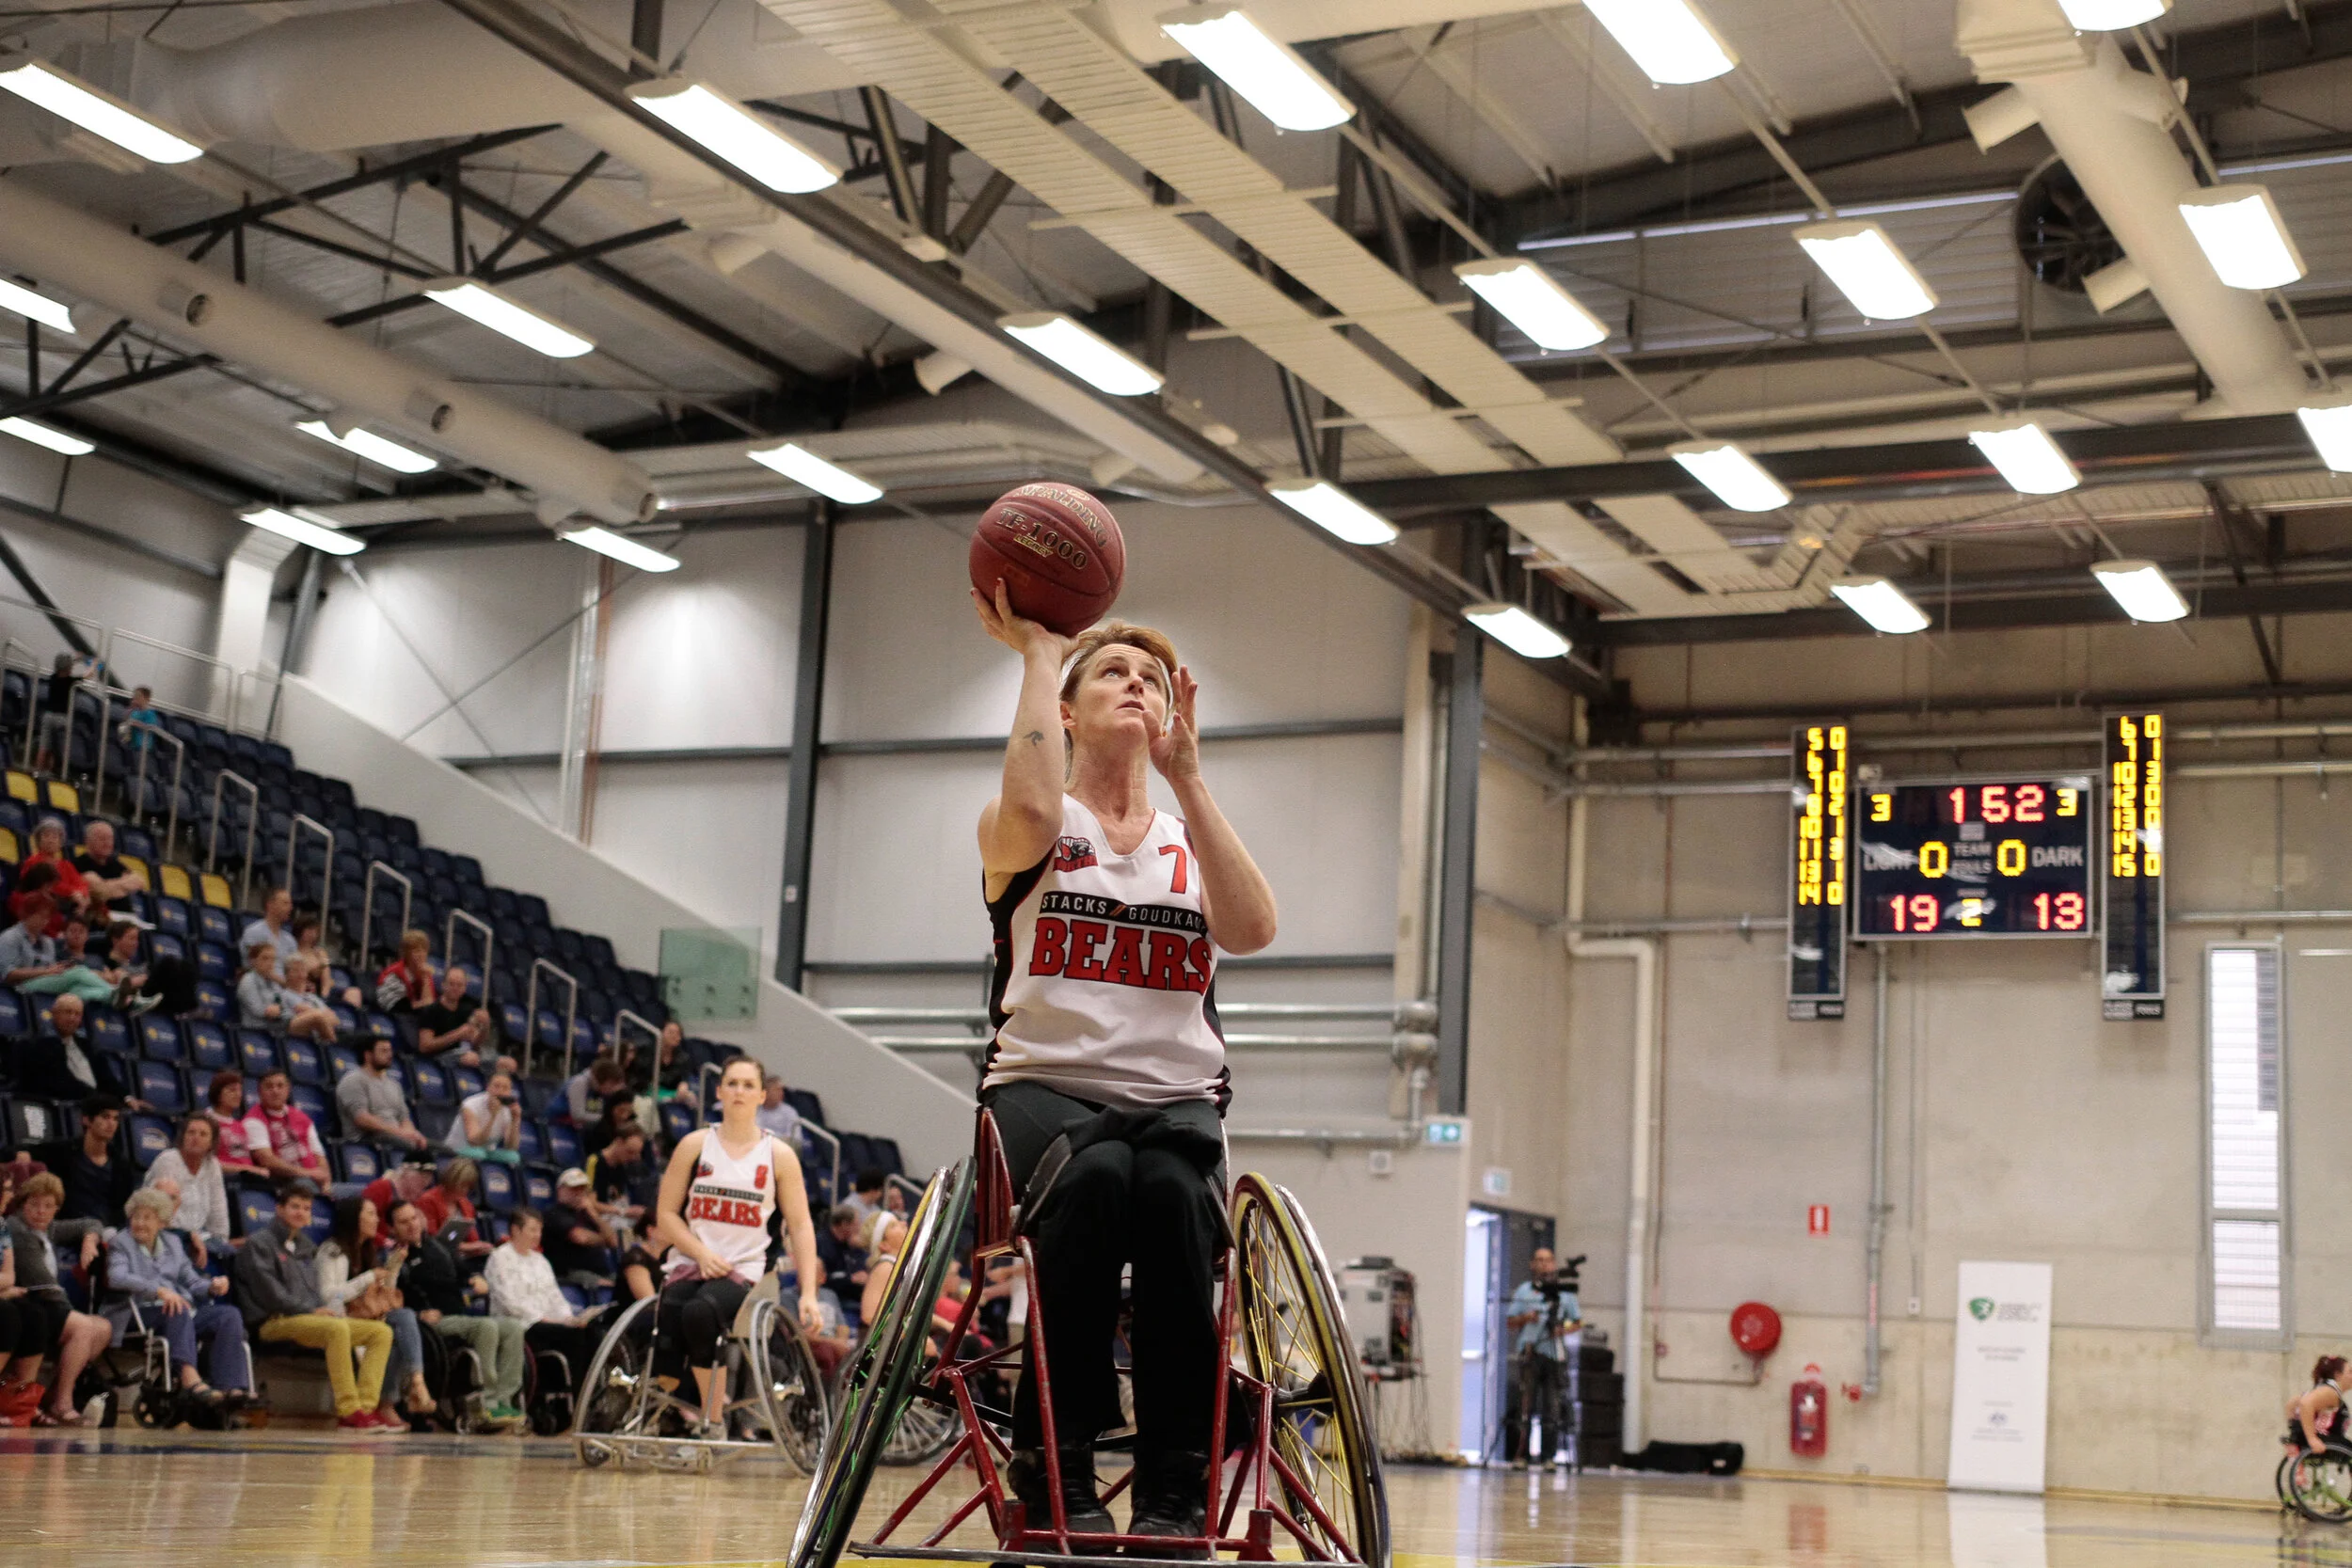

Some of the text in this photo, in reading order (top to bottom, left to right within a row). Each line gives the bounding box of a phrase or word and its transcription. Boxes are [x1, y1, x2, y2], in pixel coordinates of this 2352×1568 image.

[994, 508, 1088, 570] TF-1000
[1807, 726, 1847, 751] 5 0
[2121, 714, 2161, 739] 6 0
[1807, 750, 1823, 772] 6
[2153, 737, 2161, 761] 1
[1829, 770, 1846, 794] 0
[2113, 760, 2161, 784] 10 3
[1829, 793, 1845, 816] 2
[1870, 794, 1891, 822] 3
[2056, 788, 2077, 816] 3
[2113, 784, 2161, 808] 12 0
[1800, 816, 1822, 839] 10
[2113, 807, 2137, 831] 13
[1799, 838, 1821, 861] 11
[2113, 831, 2137, 854] 14
[1158, 844, 1186, 894] 7
[1919, 841, 1948, 878] 0
[1996, 839, 2026, 877] 0
[2032, 847, 2083, 867] DARK
[2113, 853, 2161, 877] 15 0
[1799, 860, 1821, 883] 13
[1041, 895, 1107, 915] STACKS
[1799, 880, 1843, 906] 14 0
[1890, 894, 1938, 931] 19
[2034, 893, 2083, 929] 13
[1029, 917, 1212, 996] BEARS
[691, 1196, 762, 1227] BEARS
